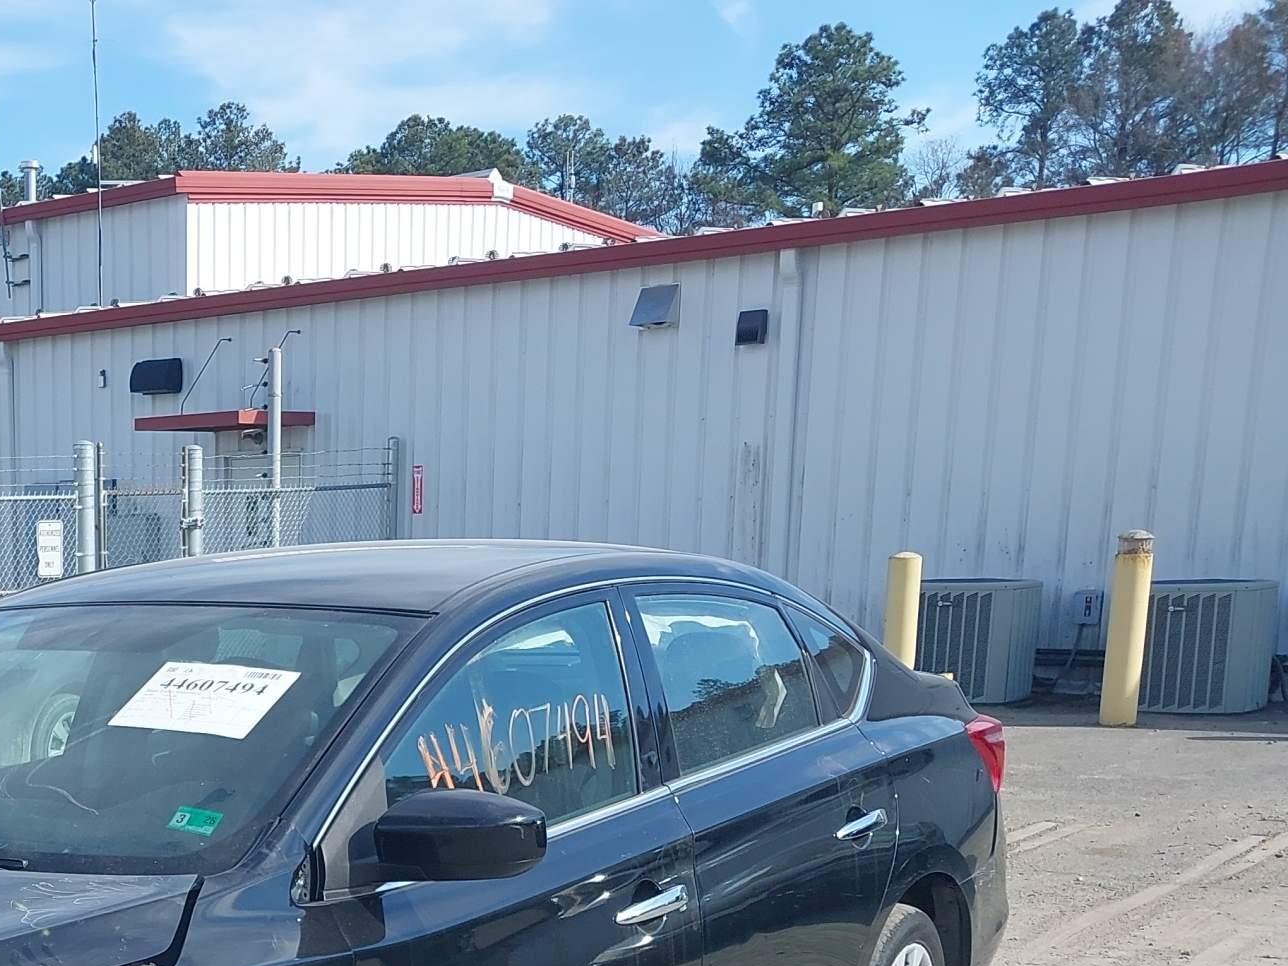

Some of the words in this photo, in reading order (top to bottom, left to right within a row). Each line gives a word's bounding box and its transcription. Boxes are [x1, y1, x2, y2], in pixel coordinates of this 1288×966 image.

[159, 677, 269, 696] 44607494
[417, 693, 617, 796] 44607494
[175, 813, 187, 824] 3
